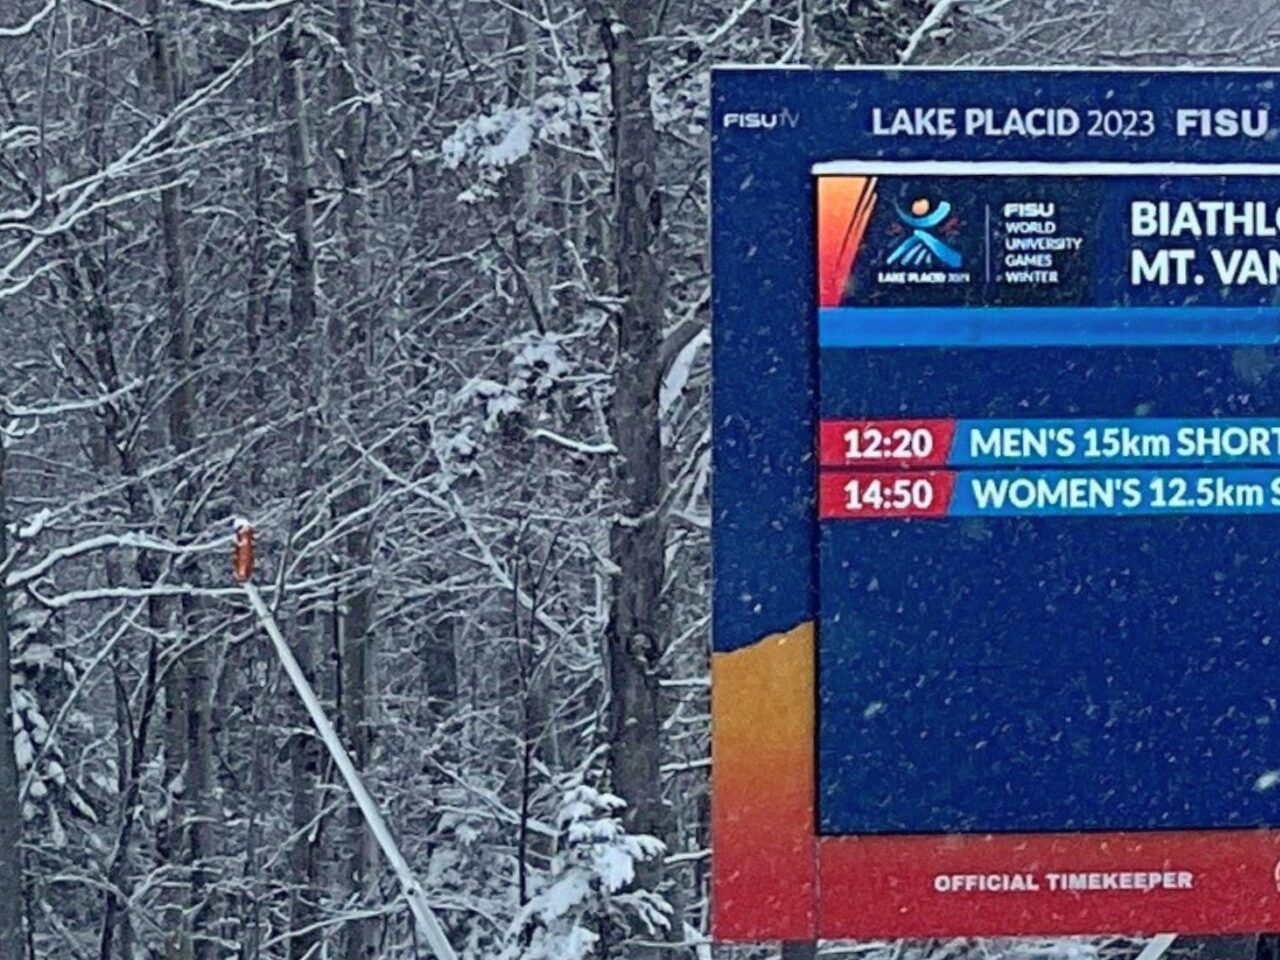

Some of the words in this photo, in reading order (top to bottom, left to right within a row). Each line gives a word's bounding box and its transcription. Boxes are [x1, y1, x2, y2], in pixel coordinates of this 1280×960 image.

[873, 108, 956, 138] LAKE
[965, 108, 1081, 138] PLACID
[1087, 110, 1156, 137] 2023
[1177, 108, 1270, 139] FISU
[1004, 202, 1054, 217] FISU
[1005, 221, 1056, 234] WORLD
[1005, 237, 1082, 250] UNIVERSITY
[1004, 254, 1052, 267] GAMES
[1131, 249, 1205, 287] MT.
[877, 272, 905, 283] LAKE
[907, 272, 946, 283] PLACID
[1005, 270, 1059, 283] WINTER
[844, 426, 933, 460] 12:20
[970, 427, 1075, 459] MEN'S
[1083, 427, 1170, 457] 15km
[844, 479, 934, 511] 14:50
[972, 478, 1143, 510] WOMEN'S
[1150, 477, 1264, 508] 12.5km
[933, 872, 1040, 893] OFFICIAL
[1045, 870, 1194, 891] TIMEKEEPER
